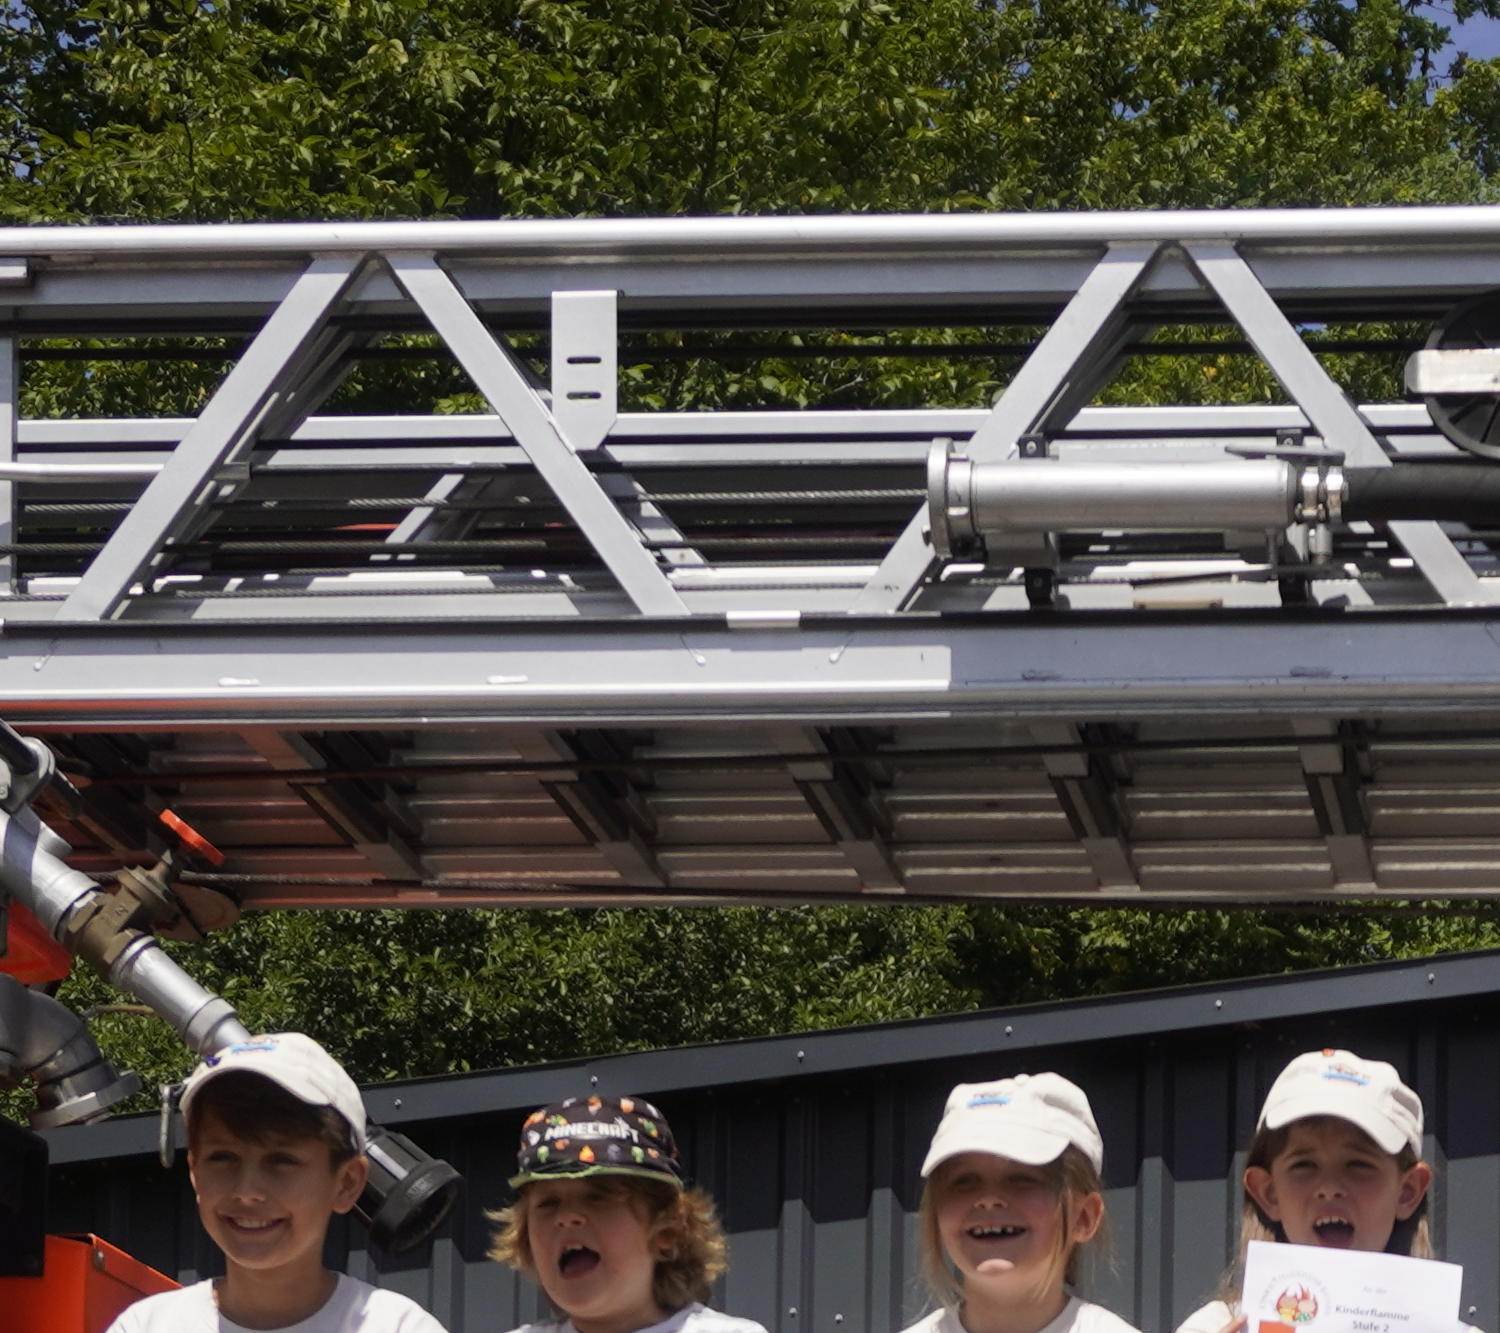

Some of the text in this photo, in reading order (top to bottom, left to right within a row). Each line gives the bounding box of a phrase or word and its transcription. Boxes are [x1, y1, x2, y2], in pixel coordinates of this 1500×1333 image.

[544, 1121, 639, 1143] MINECRAFT
[1335, 1304, 1410, 1322] Kinderflamme
[1352, 1320, 1390, 1333] Stufe 2
